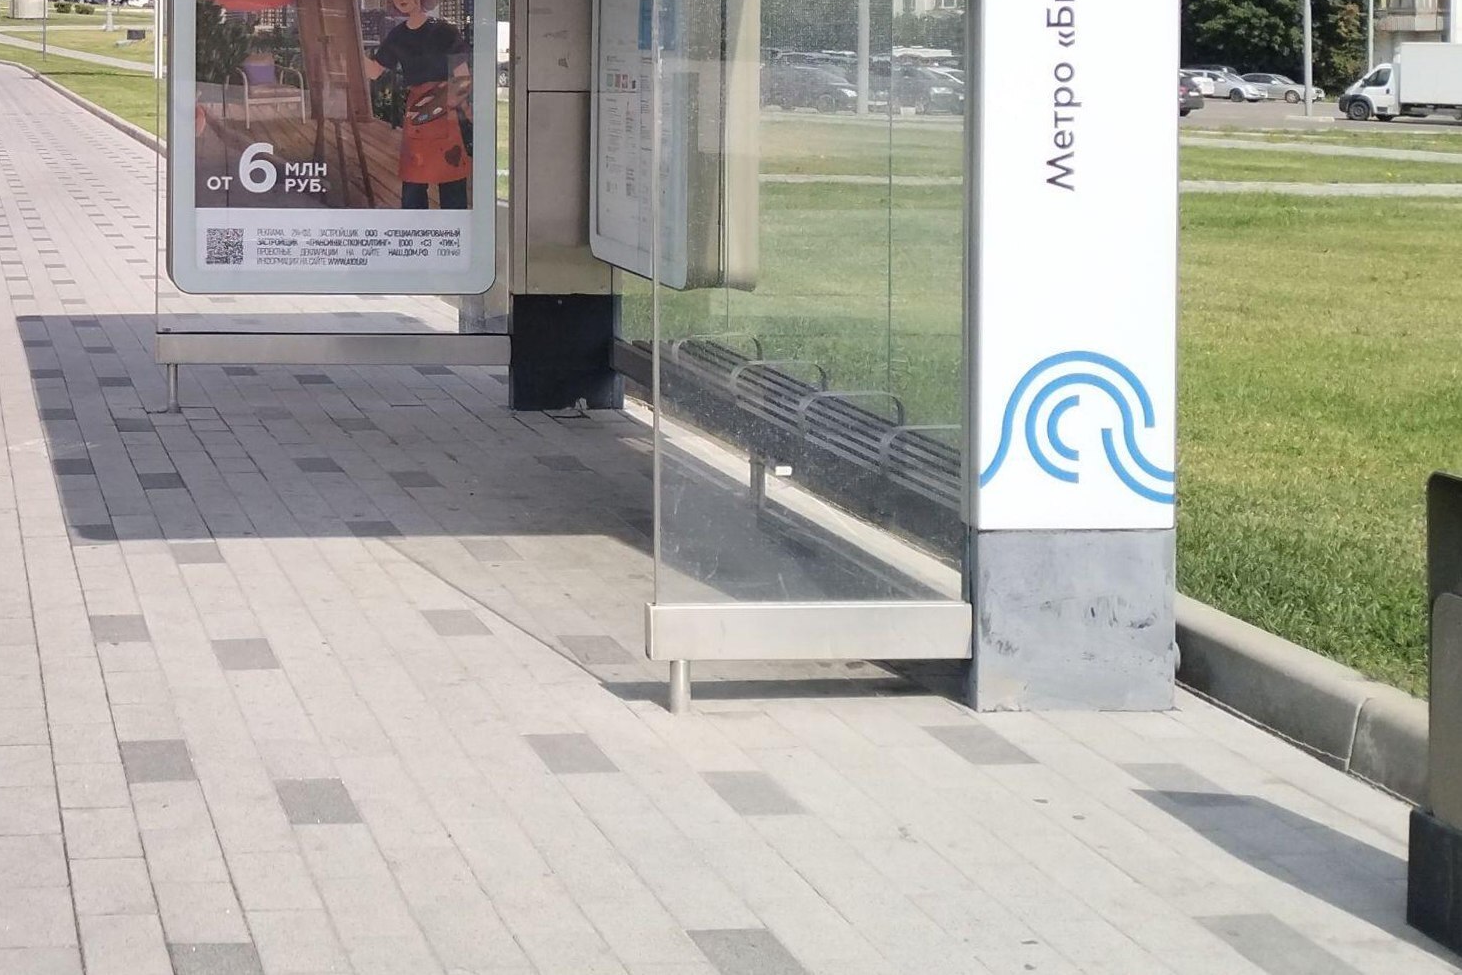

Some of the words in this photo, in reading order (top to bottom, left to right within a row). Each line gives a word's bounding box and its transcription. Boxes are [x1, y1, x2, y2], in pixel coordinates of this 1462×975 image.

[1046, 62, 1082, 191] Метро
[207, 176, 233, 190] ОТ
[239, 142, 277, 193] 6
[285, 162, 327, 176] МЛН
[285, 179, 327, 193] РУБ.
